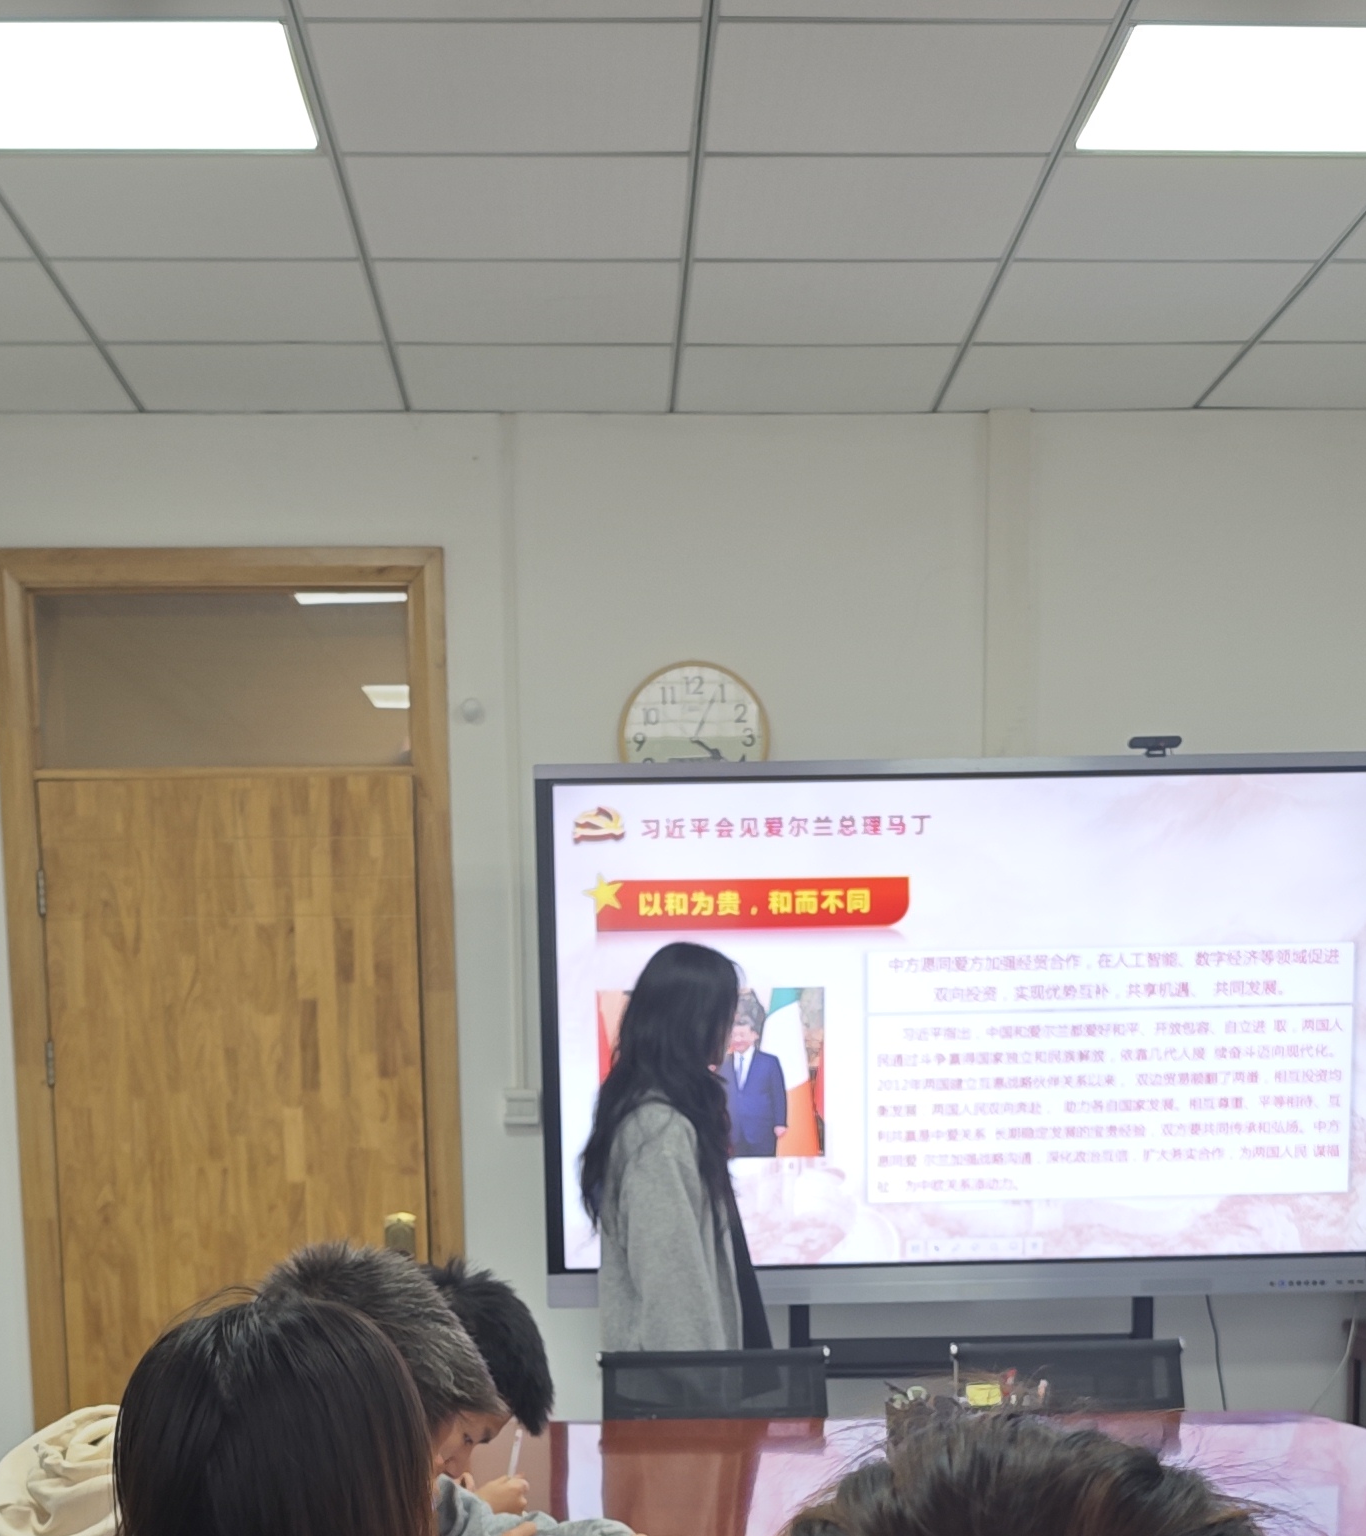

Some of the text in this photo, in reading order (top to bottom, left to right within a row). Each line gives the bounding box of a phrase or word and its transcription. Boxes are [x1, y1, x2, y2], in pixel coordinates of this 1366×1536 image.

[641, 814, 933, 839] 习近平会见爱尔兰总理马丁
[638, 888, 871, 917] 以和为贵，和而不同
